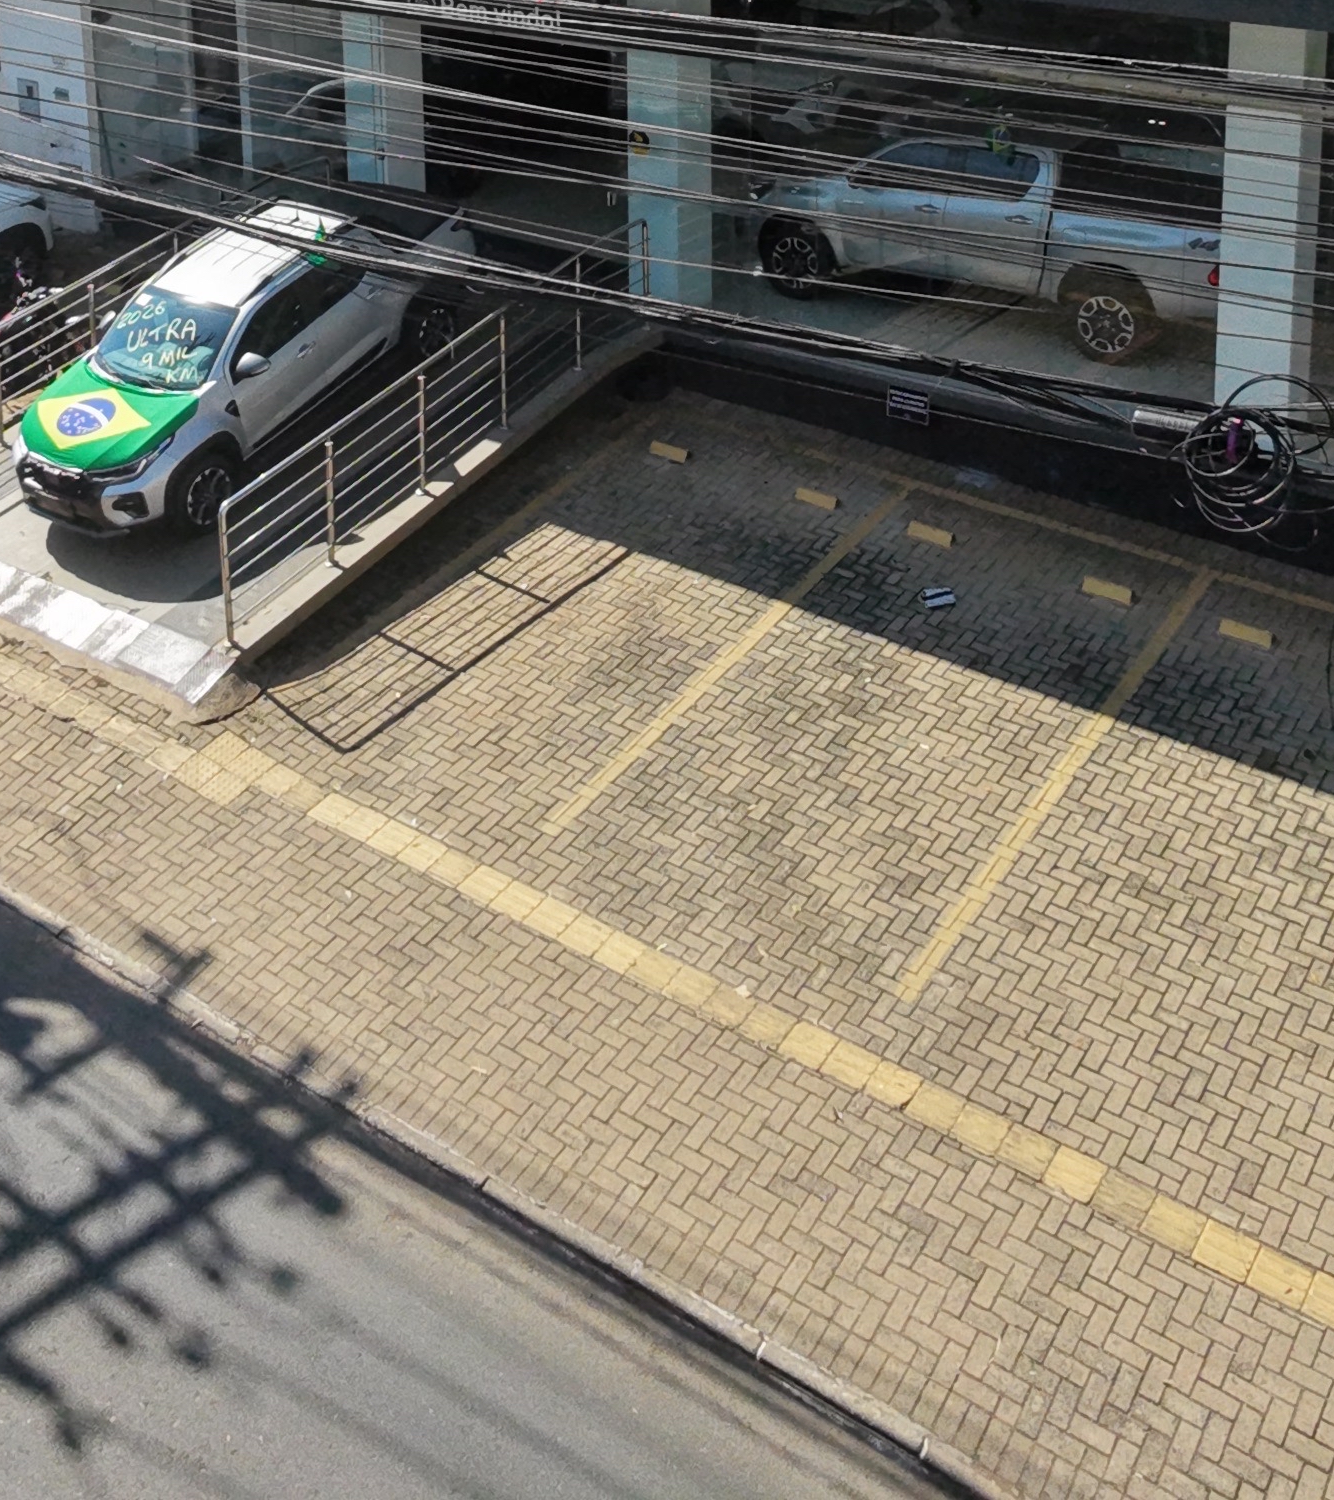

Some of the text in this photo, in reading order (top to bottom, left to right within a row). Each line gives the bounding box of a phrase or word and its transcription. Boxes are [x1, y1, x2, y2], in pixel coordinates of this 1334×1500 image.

[117, 300, 167, 330] 2026
[127, 317, 197, 353] ULTRA
[141, 346, 198, 370] 9 MIL
[166, 366, 201, 386] KM
